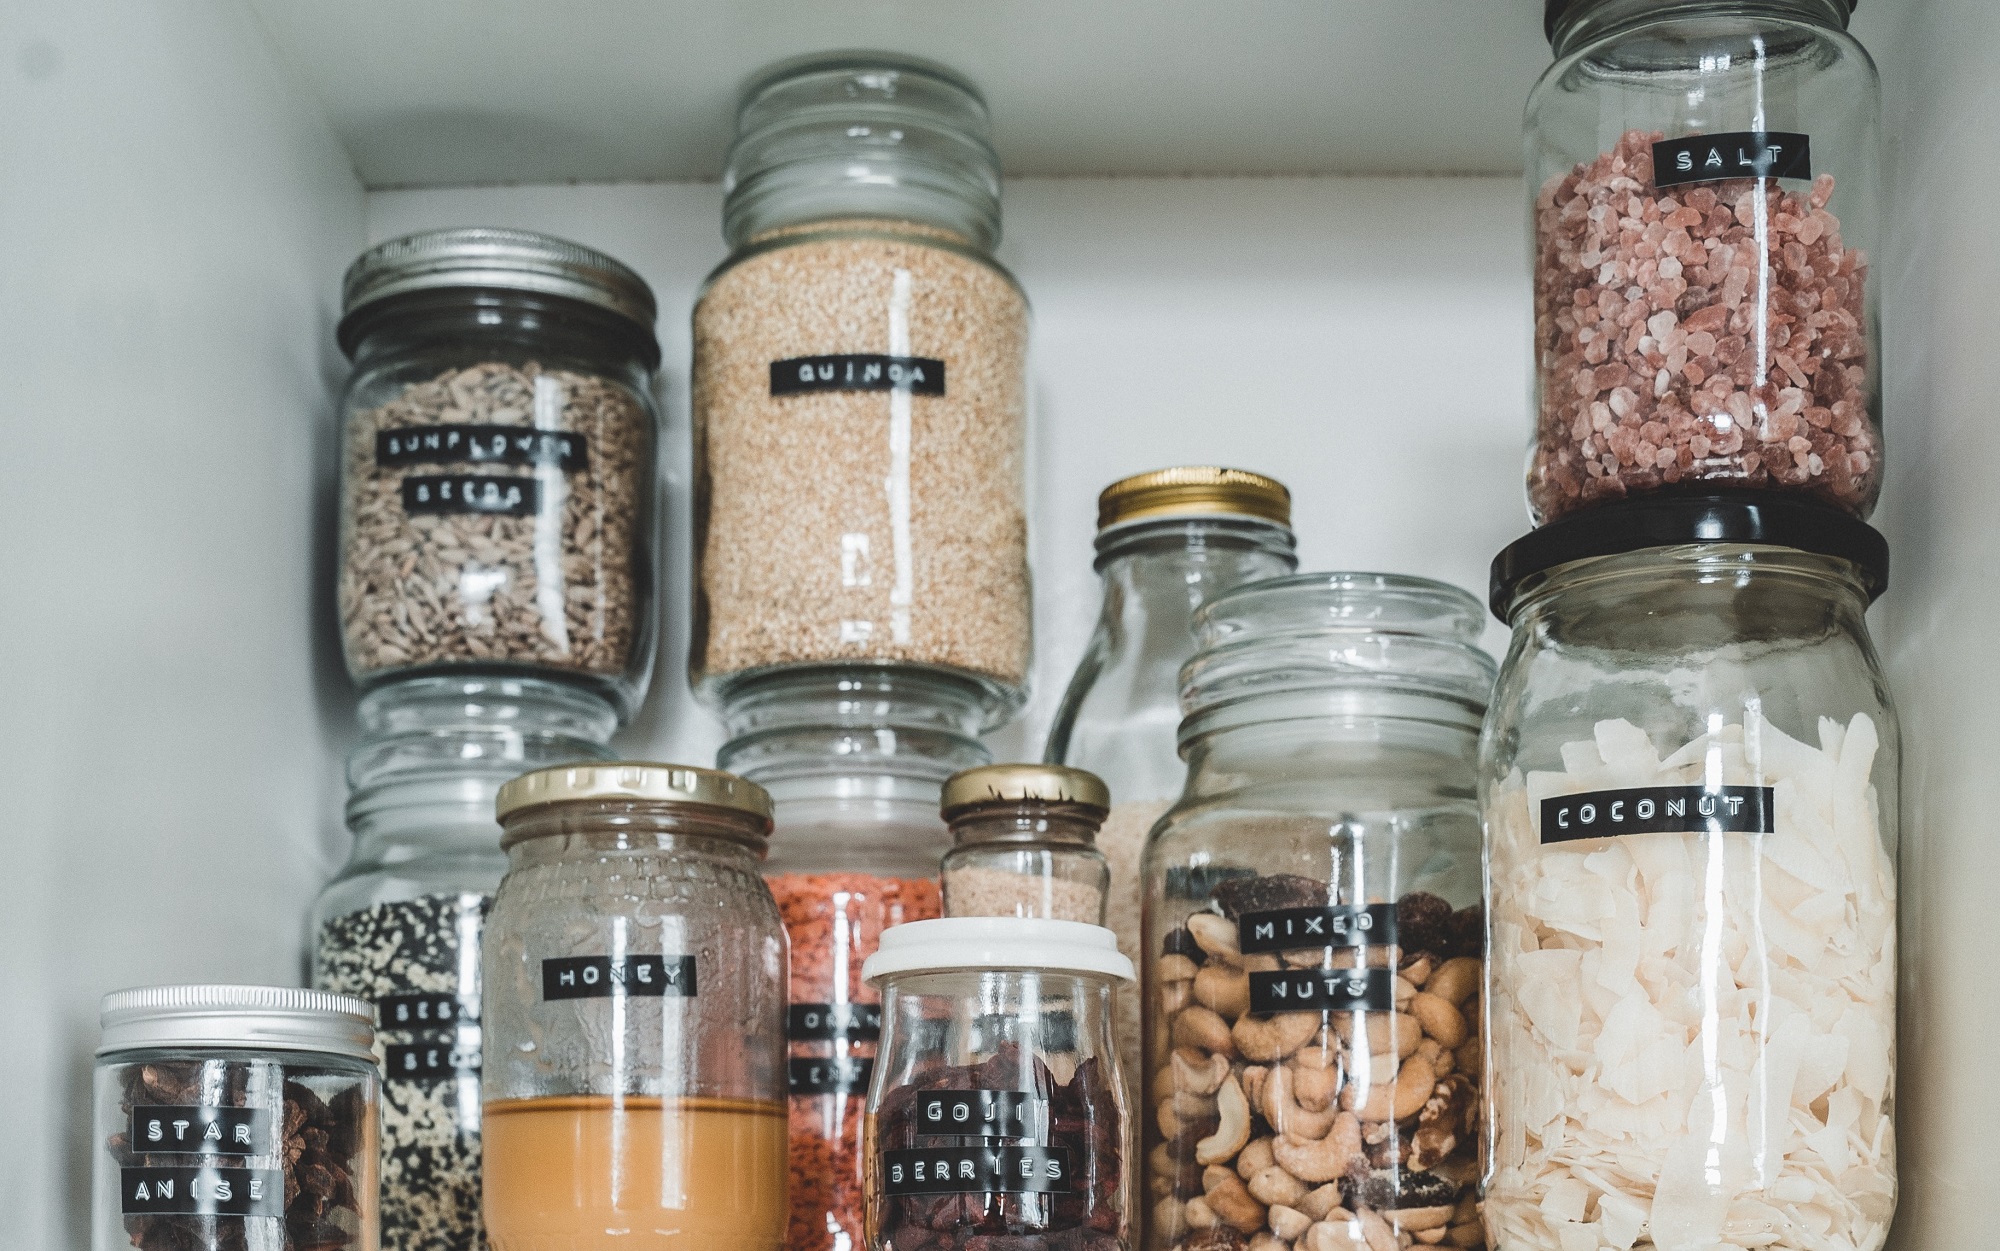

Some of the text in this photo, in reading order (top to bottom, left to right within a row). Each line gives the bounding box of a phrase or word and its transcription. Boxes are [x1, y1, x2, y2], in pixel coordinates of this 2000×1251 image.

[1676, 145, 1782, 171] SALT
[799, 362, 925, 382] QUINOA
[417, 481, 521, 504] SEEDS
[1559, 795, 1744, 829] COCONUT
[1255, 913, 1373, 939] MIXED
[560, 963, 681, 987] HONEY
[1272, 978, 1367, 998] NUTS
[927, 1101, 1024, 1122] GOJI
[147, 1119, 251, 1145] STAR
[892, 1156, 1062, 1184] BERRIES
[135, 1178, 263, 1202] ANISE
